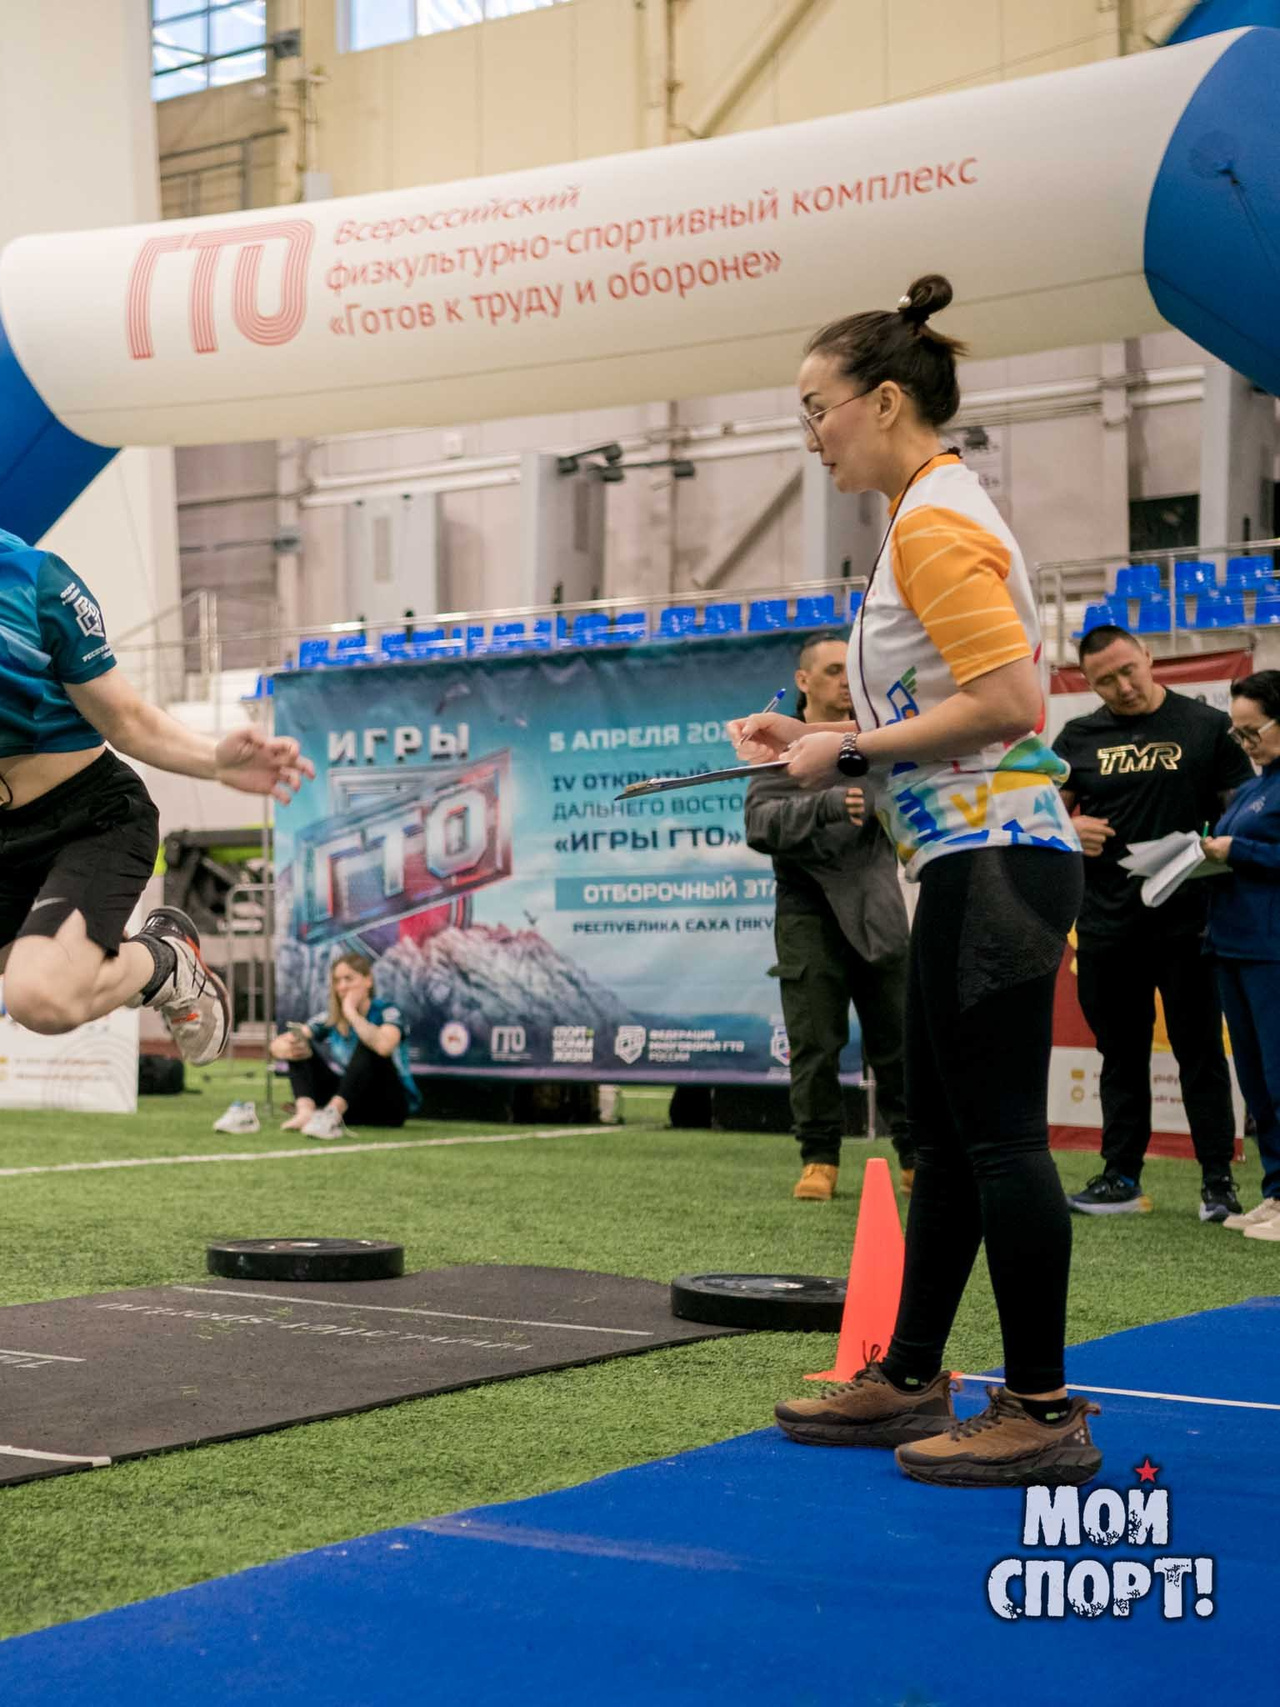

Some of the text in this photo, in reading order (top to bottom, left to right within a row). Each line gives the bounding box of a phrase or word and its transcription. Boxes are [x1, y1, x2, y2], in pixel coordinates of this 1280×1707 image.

[325, 156, 980, 293] физкультурно-спортивный комплекс
[332, 183, 582, 247] Всероссийский
[125, 217, 317, 361] ГТО
[329, 248, 783, 338] «Готов к труду и обороне»
[327, 722, 470, 764] ИГРЫ
[549, 732, 565, 752] 5
[571, 724, 680, 752] АПРЕЛЯ
[1096, 741, 1182, 775] TMR
[553, 793, 744, 821] ДАЛЬНЕГО ВОСТО
[310, 786, 490, 921] ГТО
[554, 826, 742, 852] «ИГРЫ ГТО»
[583, 874, 737, 904] ОТБОРОЧНЫЙ
[573, 917, 681, 935] РЕСПУБЛИКА
[685, 915, 730, 932] САХА
